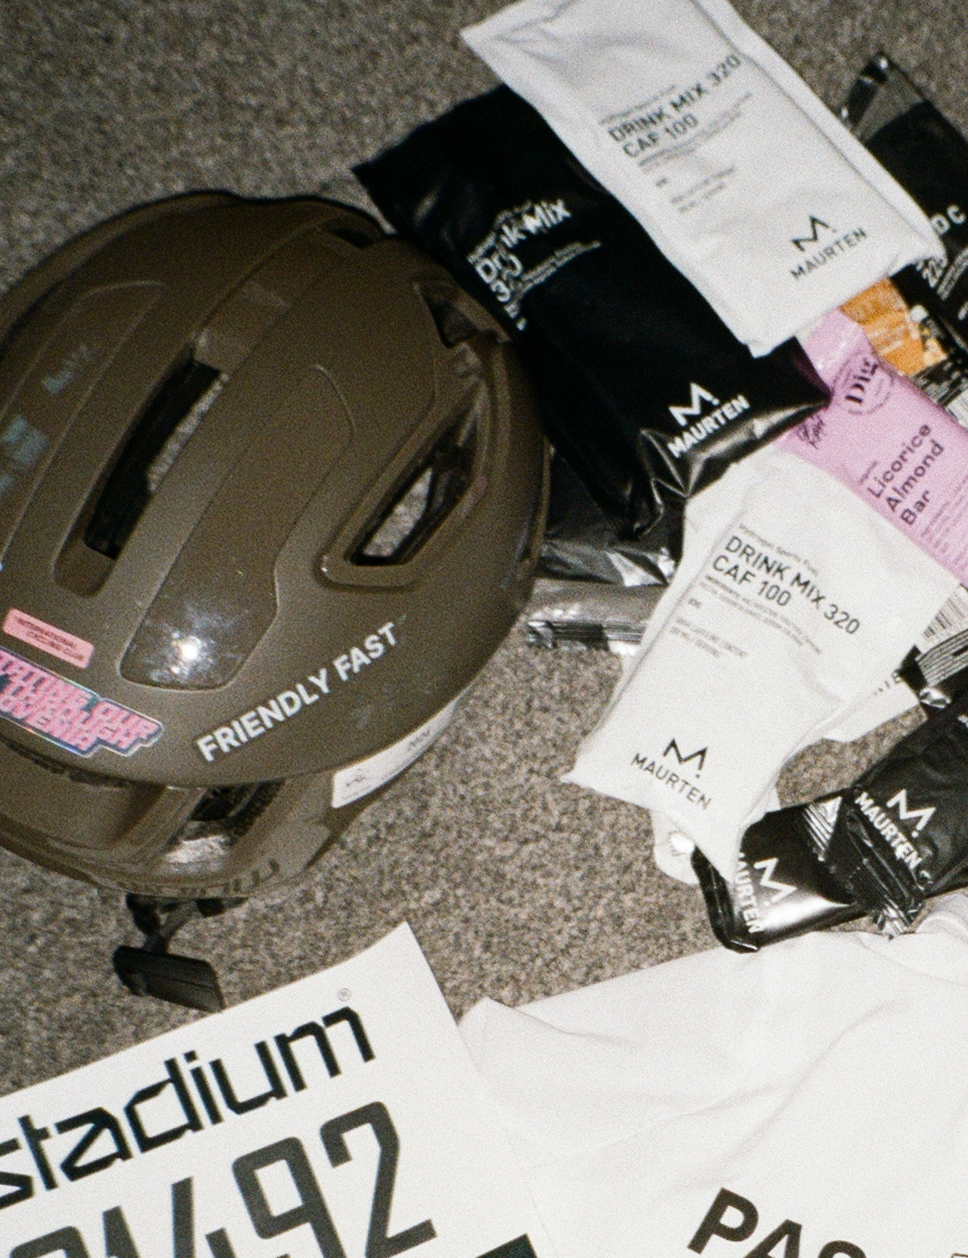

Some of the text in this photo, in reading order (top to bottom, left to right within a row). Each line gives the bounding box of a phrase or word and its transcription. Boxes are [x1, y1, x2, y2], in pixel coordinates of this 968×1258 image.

[608, 108, 670, 144] DRINK
[670, 83, 709, 116] MIX
[708, 53, 743, 88] 320
[621, 113, 699, 159] CAF 100
[789, 227, 868, 282] MAURTEN
[667, 394, 750, 458] MAURTEN
[867, 424, 931, 499] Licorice
[885, 439, 944, 514] Almond
[900, 490, 932, 526] Bar
[712, 555, 792, 607] CAF 100
[725, 536, 789, 581] DRINK
[791, 571, 827, 607] MIX
[823, 603, 860, 635] 320
[196, 622, 399, 763] FRIENDLY FAST
[631, 752, 712, 810] MAURTEN
[854, 791, 922, 871] MAURTEN
[735, 852, 765, 934] AURTEN
